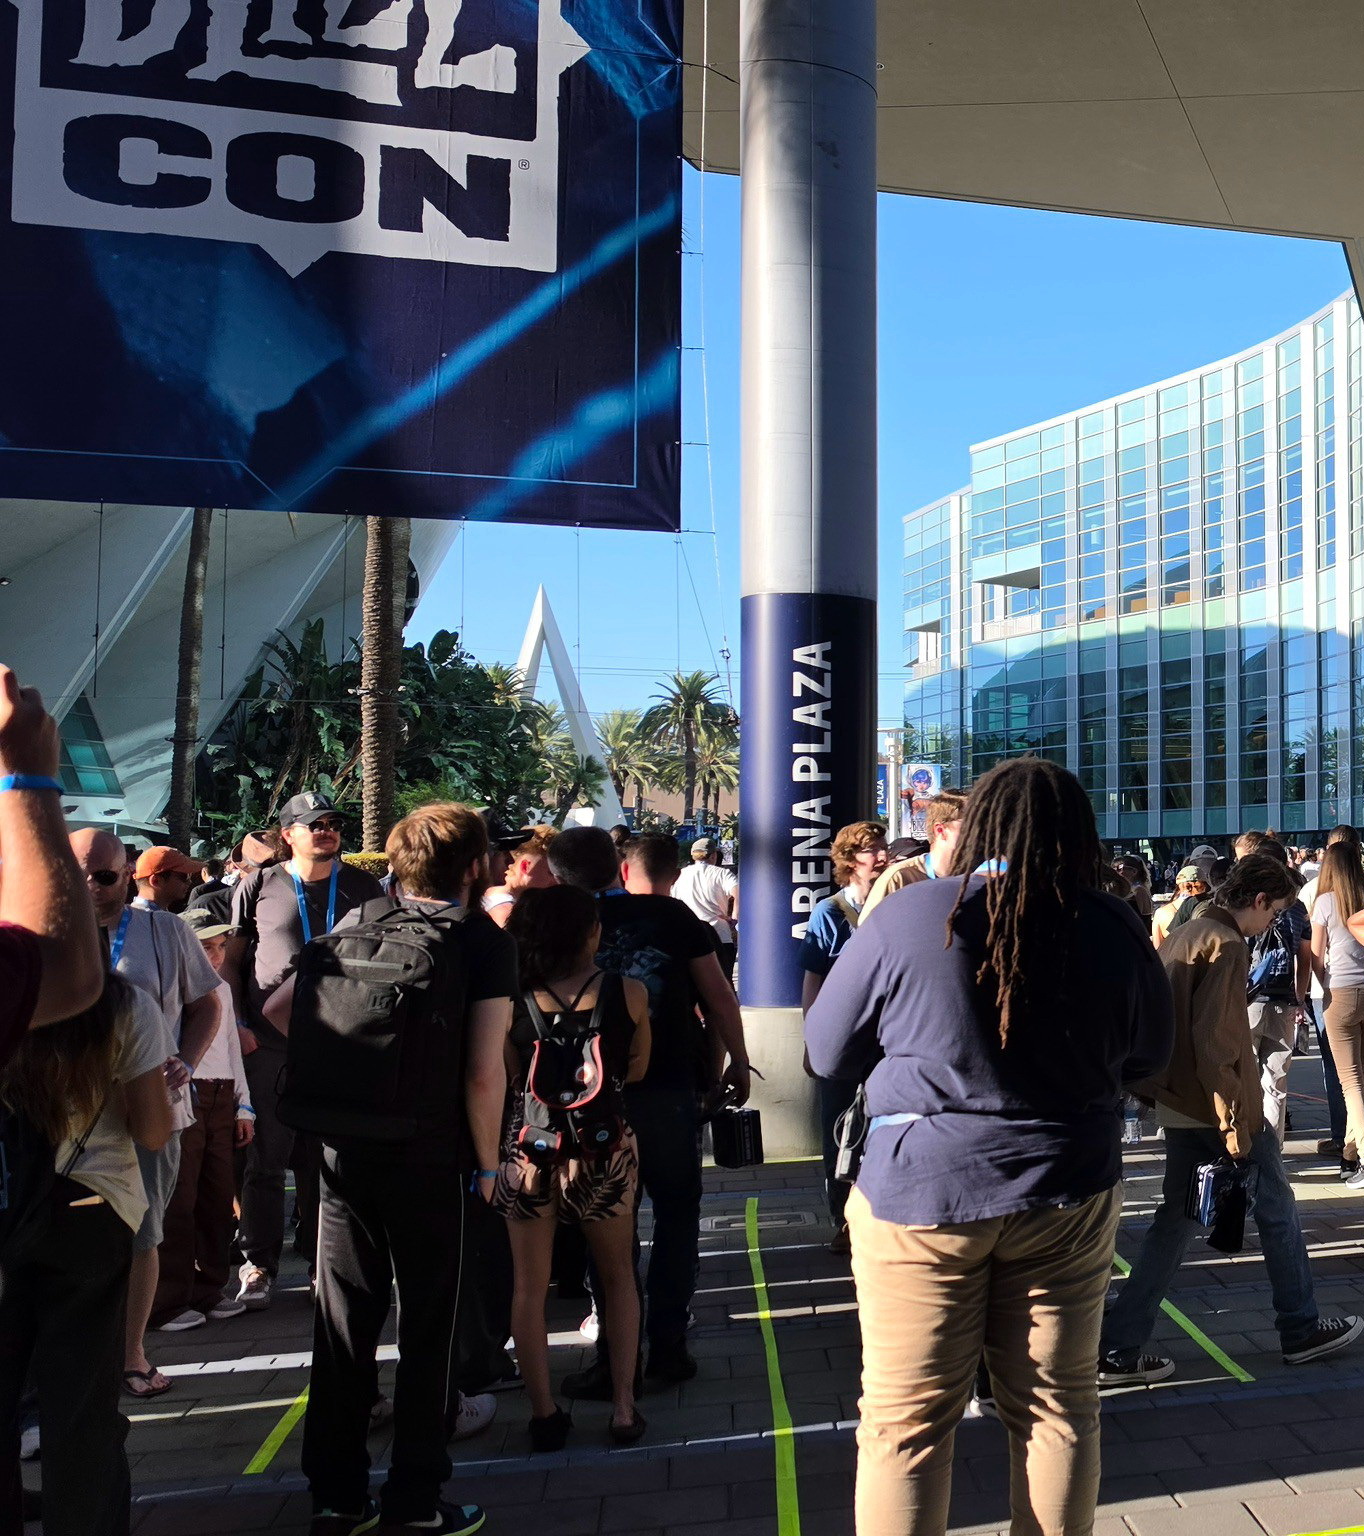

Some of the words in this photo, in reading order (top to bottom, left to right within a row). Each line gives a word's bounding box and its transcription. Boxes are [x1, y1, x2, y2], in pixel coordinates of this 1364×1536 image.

[63, 113, 512, 241] CON
[792, 641, 831, 782] PLAZA
[876, 779, 884, 804] PLAZA
